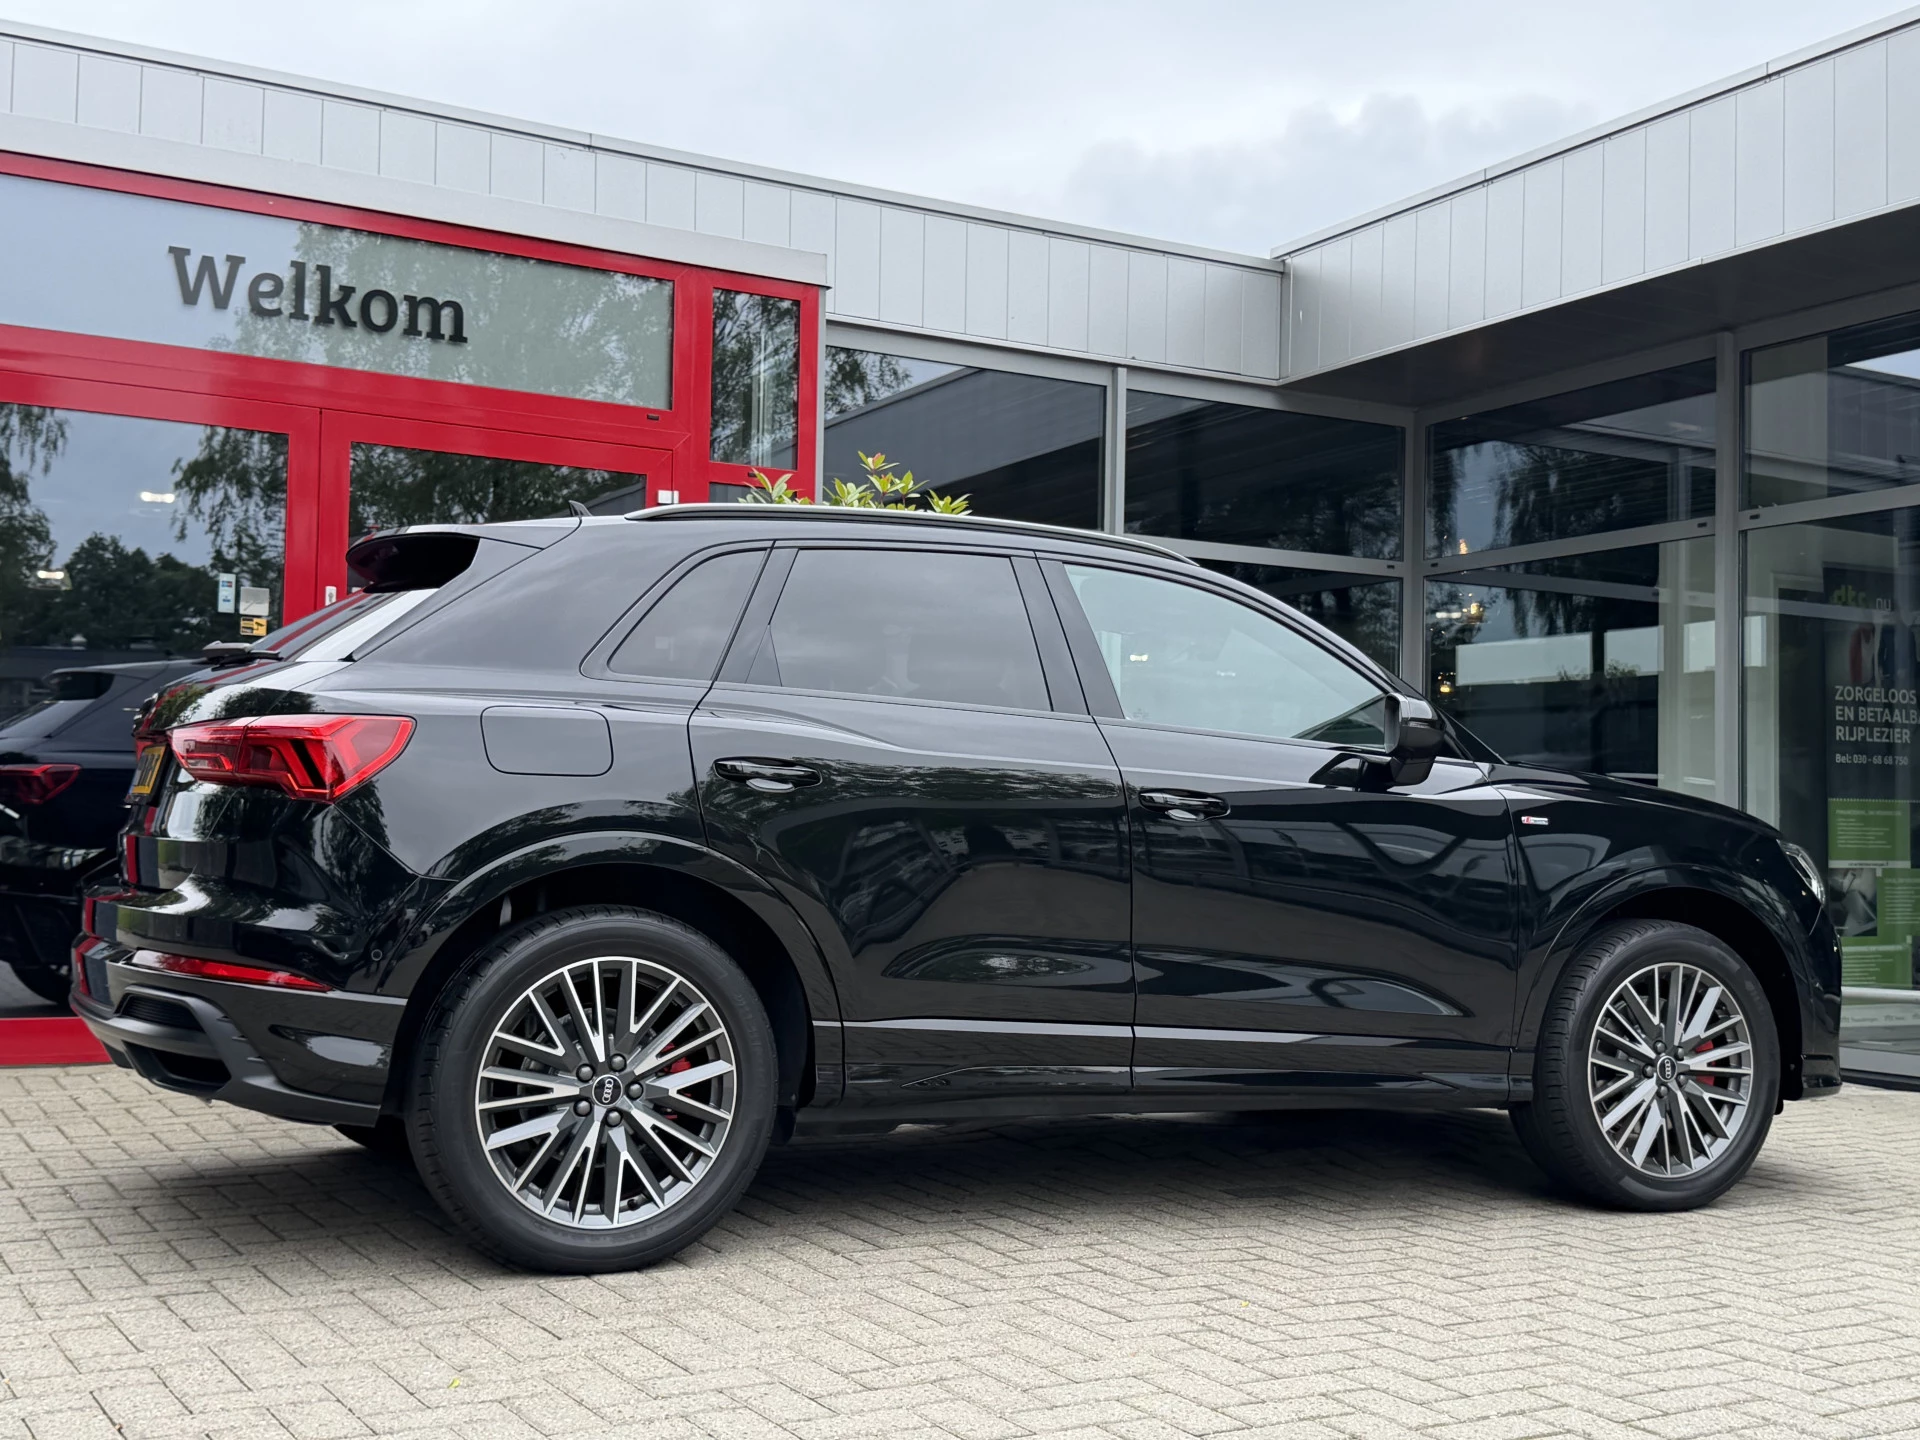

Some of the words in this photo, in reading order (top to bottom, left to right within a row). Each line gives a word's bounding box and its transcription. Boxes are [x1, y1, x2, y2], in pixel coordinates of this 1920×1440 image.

[168, 245, 468, 343] Welkom
[1835, 685, 1917, 704] ZORGELOOS
[1835, 705, 1855, 721] EN
[1835, 725, 1911, 743] RIJPLEZIER
[1835, 753, 1852, 763] Bel:
[1853, 754, 1867, 764] 030
